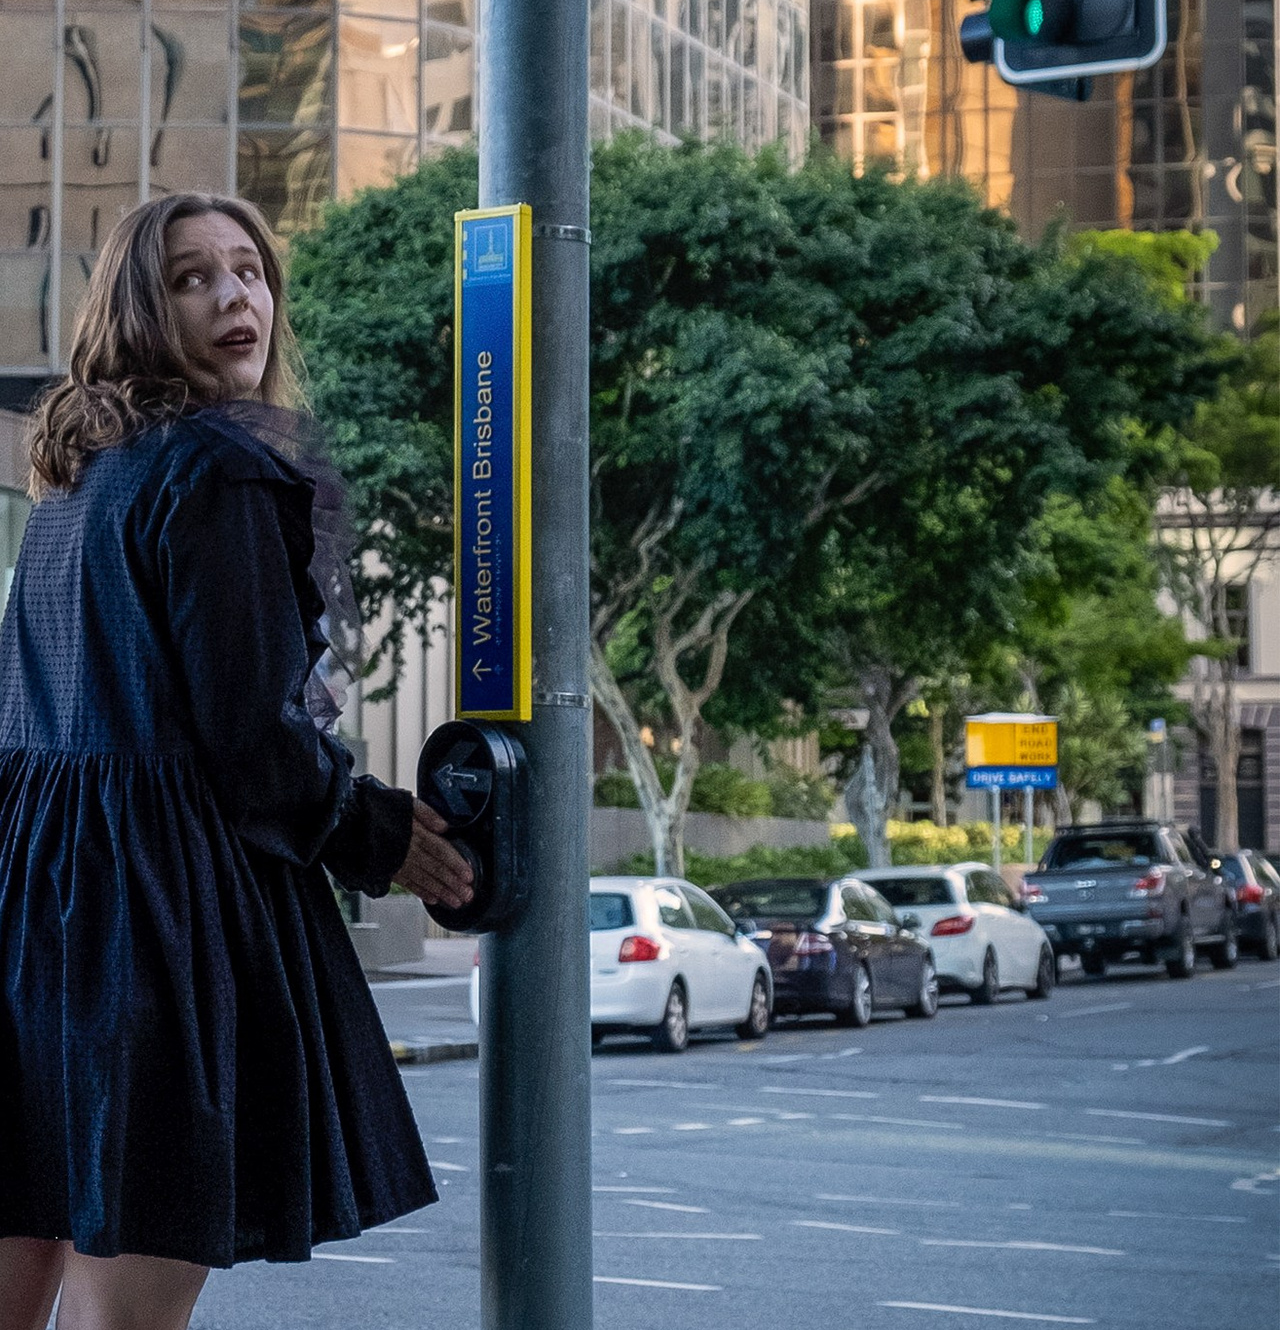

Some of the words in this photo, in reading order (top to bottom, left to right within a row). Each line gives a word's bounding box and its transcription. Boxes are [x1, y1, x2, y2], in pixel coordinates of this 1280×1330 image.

[472, 350, 493, 480] Brisbane
[472, 488, 493, 646] Waterfront
[972, 771, 1004, 783] DRIVE
[1008, 771, 1051, 783] SAFELY
